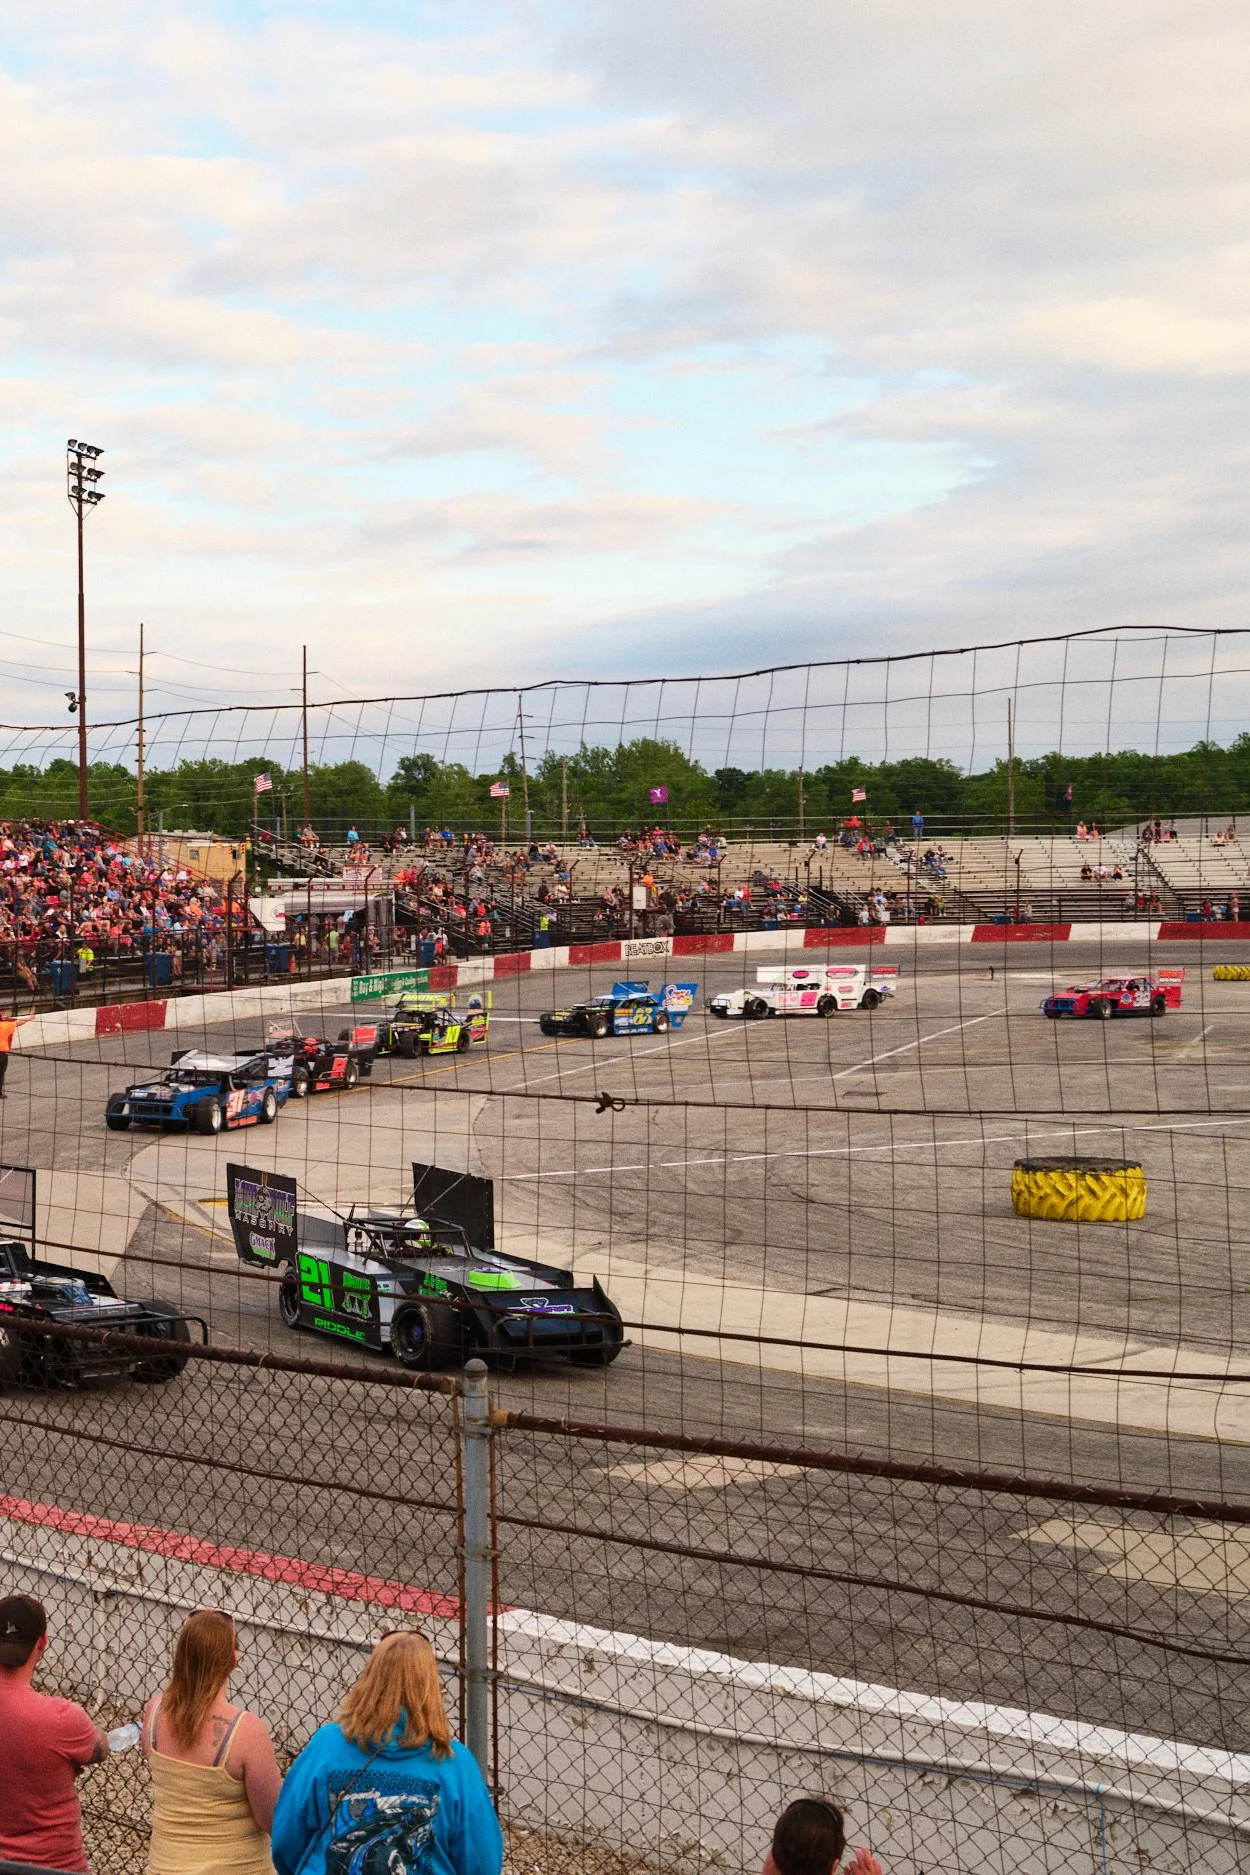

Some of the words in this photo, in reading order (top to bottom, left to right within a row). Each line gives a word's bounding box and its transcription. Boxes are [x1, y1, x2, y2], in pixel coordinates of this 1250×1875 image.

[624, 941, 670, 956] BEATBOX
[225, 1089, 246, 1119] 31
[234, 1209, 293, 1236] MASONRY
[297, 1253, 335, 1311] 21
[314, 1317, 366, 1342] RIDDLE
